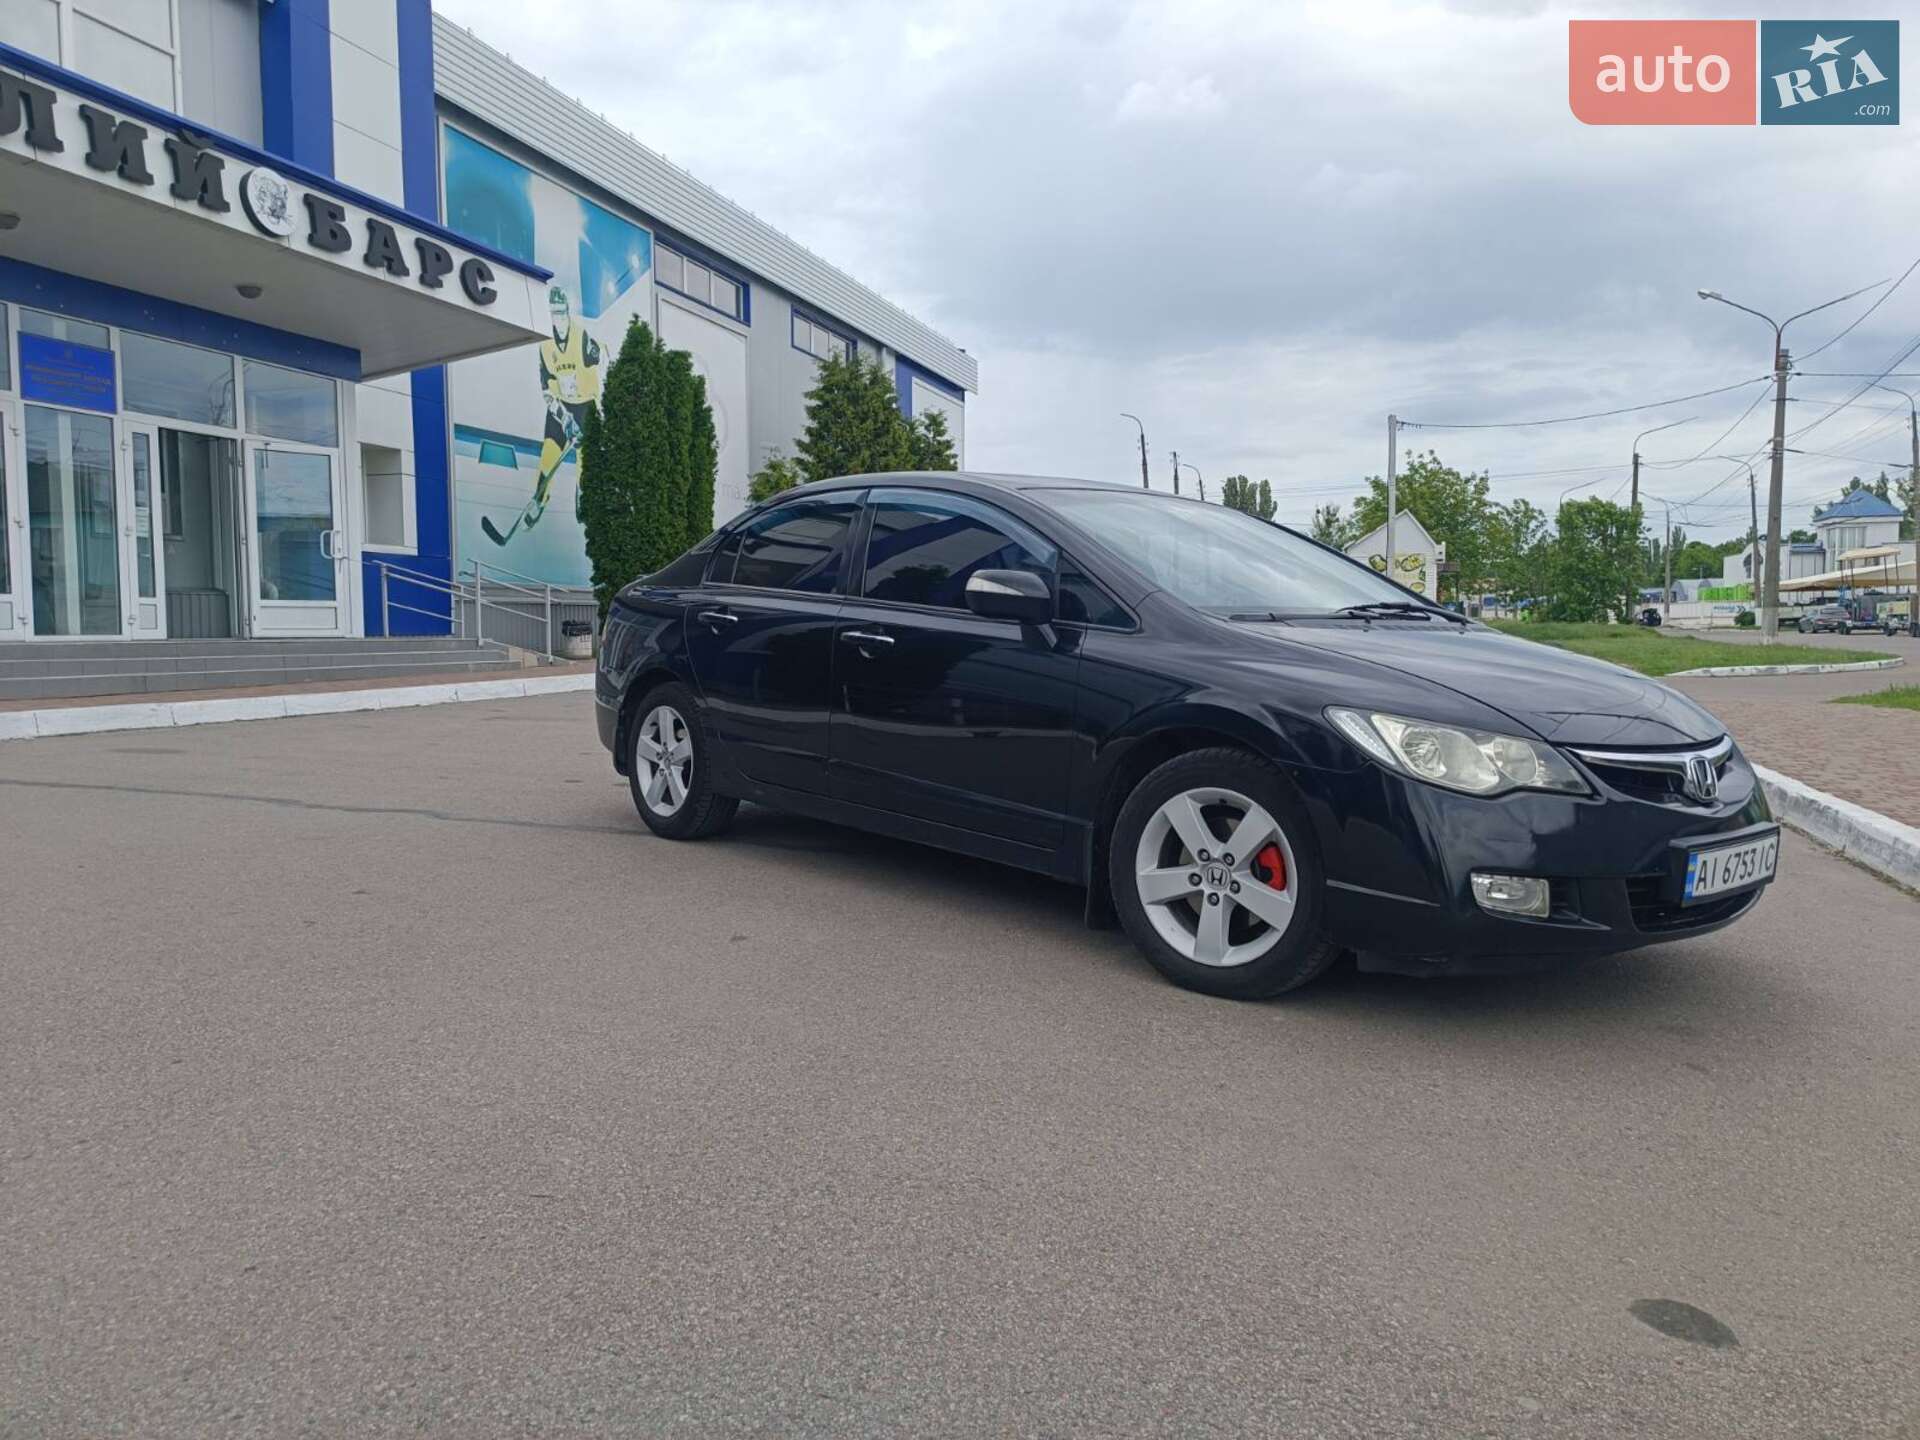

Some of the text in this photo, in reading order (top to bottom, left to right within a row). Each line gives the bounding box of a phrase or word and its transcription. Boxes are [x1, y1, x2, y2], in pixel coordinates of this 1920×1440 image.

[303, 193, 497, 305] БАРС
[1696, 858, 1717, 891] AI
[1722, 848, 1757, 884] 6753
